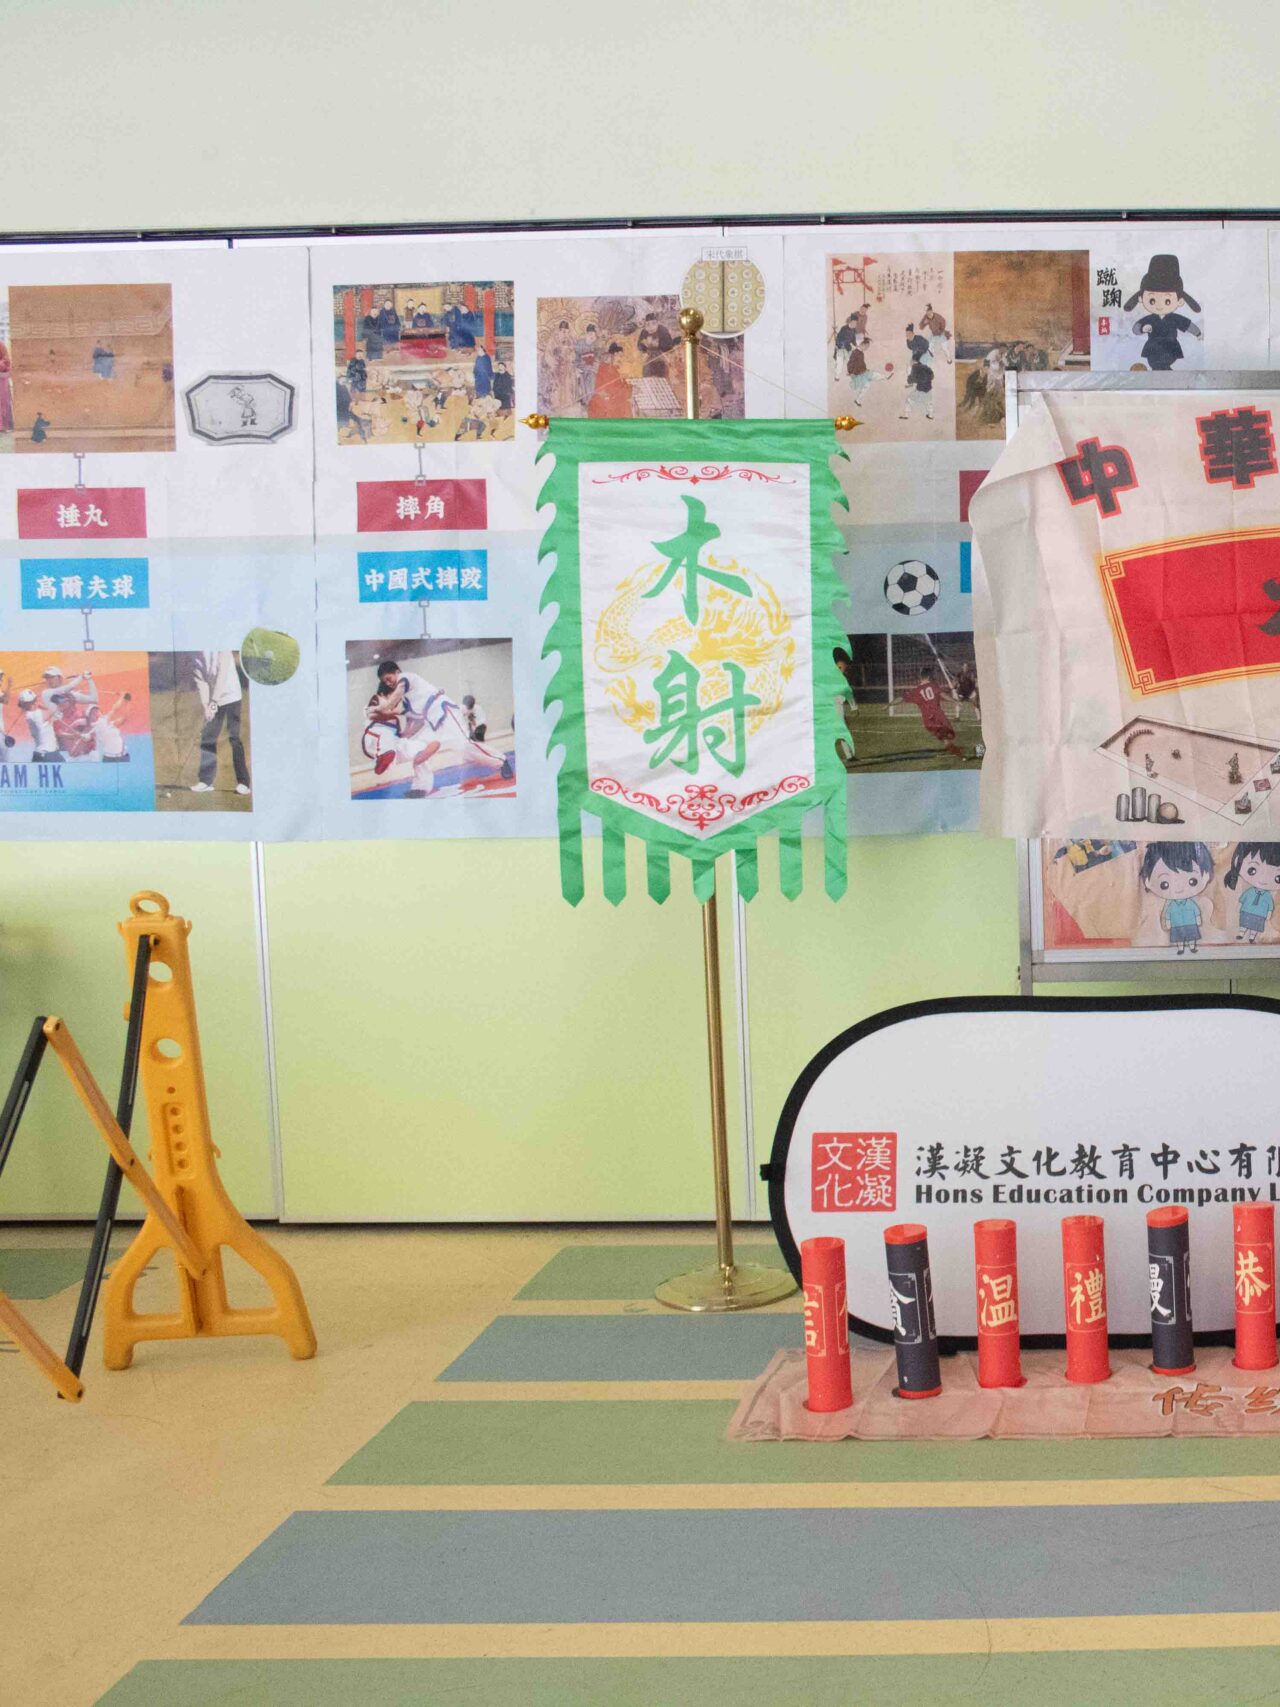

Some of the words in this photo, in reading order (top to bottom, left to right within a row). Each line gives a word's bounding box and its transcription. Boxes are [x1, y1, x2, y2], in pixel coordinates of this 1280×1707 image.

[57, 504, 108, 528] 捶丸
[396, 495, 444, 520] 摔角
[37, 574, 135, 599] 高爾夫球
[364, 566, 483, 592] 中國式摔跤
[641, 494, 762, 779] 木射
[920, 686, 935, 702] 10
[38, 764, 64, 789] HK
[915, 1184, 983, 1204] Hons
[992, 1184, 1128, 1204] Education
[1137, 1184, 1260, 1207] Company
[1235, 1250, 1271, 1306] 恭
[1070, 1268, 1106, 1325] 禮
